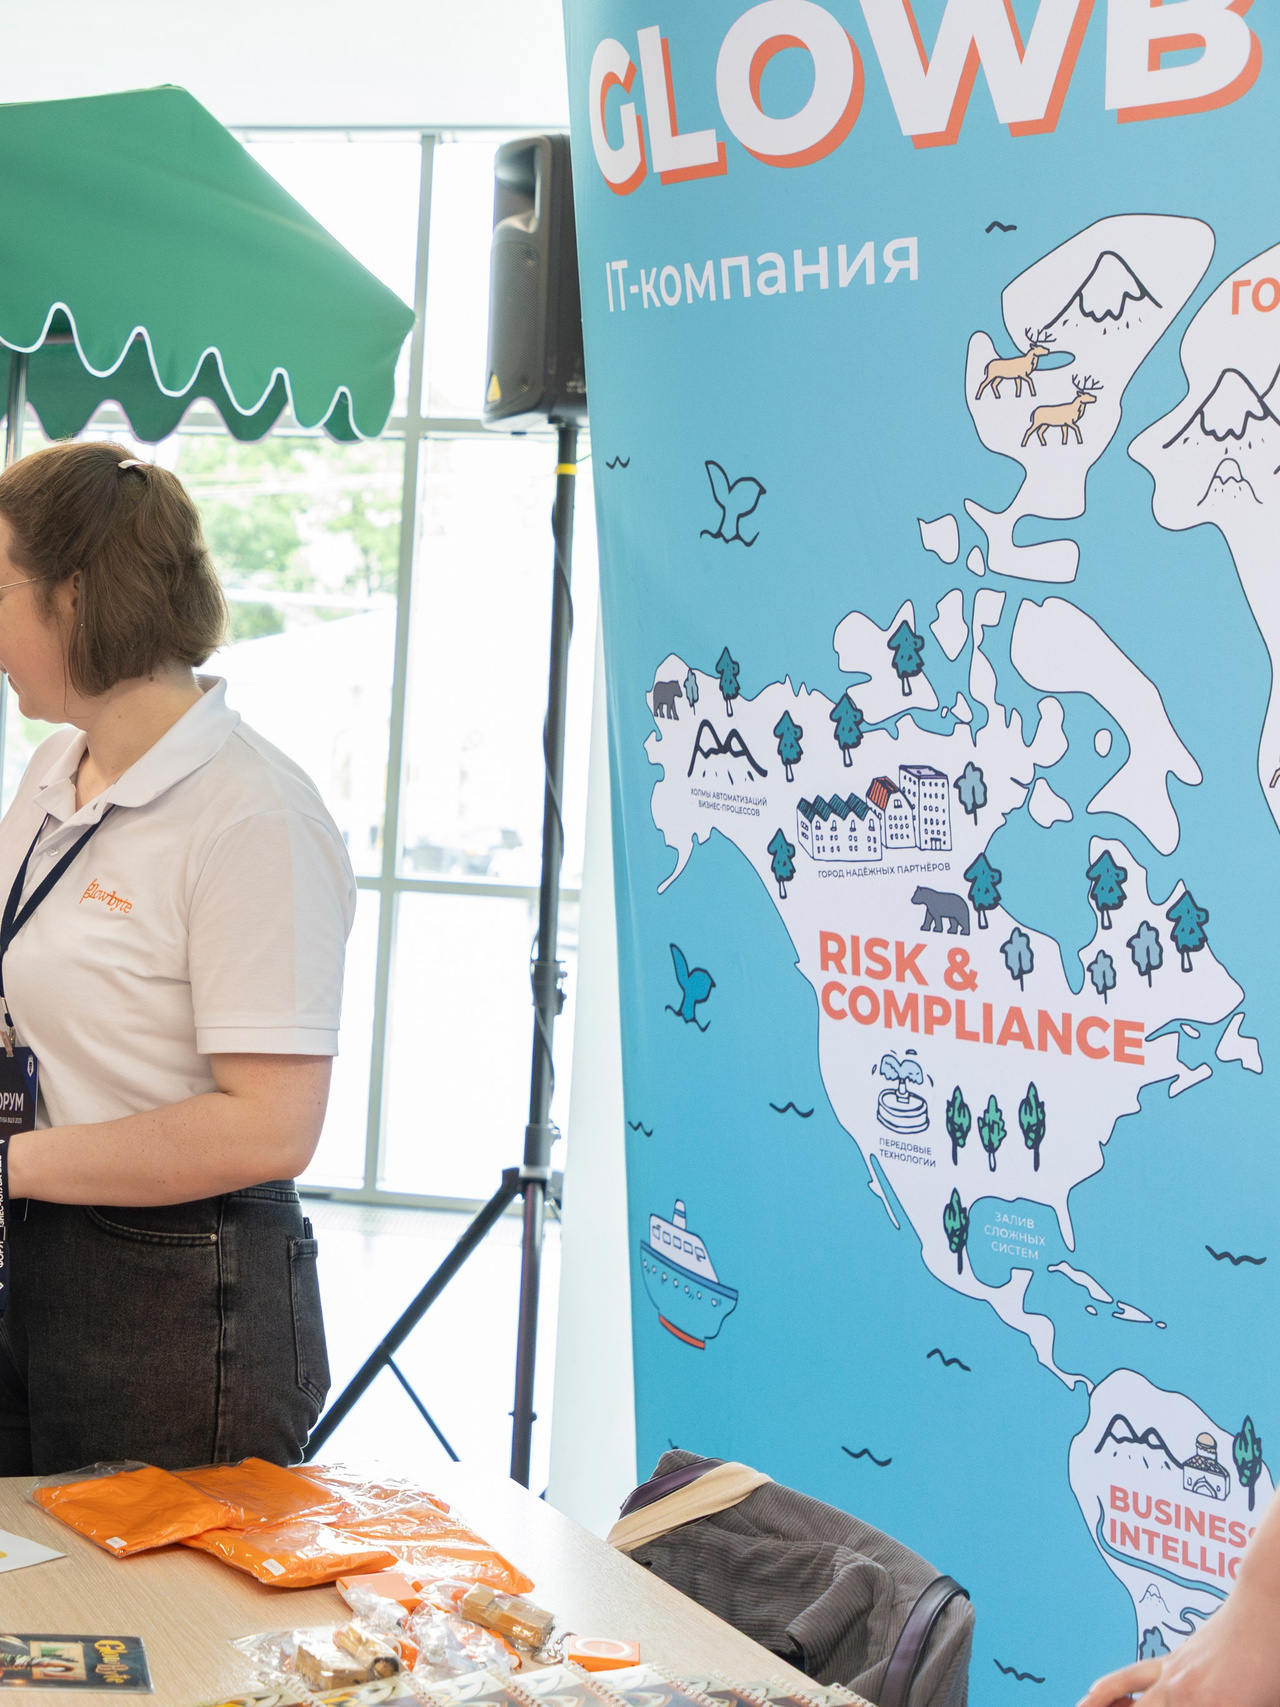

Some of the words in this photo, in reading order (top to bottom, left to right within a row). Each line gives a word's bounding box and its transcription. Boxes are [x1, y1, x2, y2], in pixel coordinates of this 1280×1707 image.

[589, 0, 1262, 196] GLOWB
[606, 236, 919, 312] IT-компания
[690, 788, 711, 798] ХОЛМЫ
[712, 792, 767, 807] АВТОМАТИЗАЦИЙ
[698, 800, 761, 817] БИЗНЕС-ПРОЦЕССОВ
[818, 870, 844, 878] ГОРОД
[846, 866, 895, 877] НАДЁЖНЫХ
[897, 862, 951, 873] ПАРТНЁРОВ
[79, 878, 133, 914] glowbyte
[819, 930, 929, 986] RISK
[944, 947, 979, 992] &
[821, 981, 1145, 1065] COMPLIANCE
[879, 1137, 932, 1156] ПЕРЕДОВЫЕ
[879, 1148, 937, 1168] ТЕХНОЛОГИИ
[995, 1211, 1035, 1229] ЗАЛИВ
[984, 1224, 1046, 1247] СЛОЖНЫХ
[991, 1241, 1038, 1260] СИСТЕМ
[1110, 1484, 1257, 1549] BUSINES
[94, 1639, 131, 1684] GlowByte
